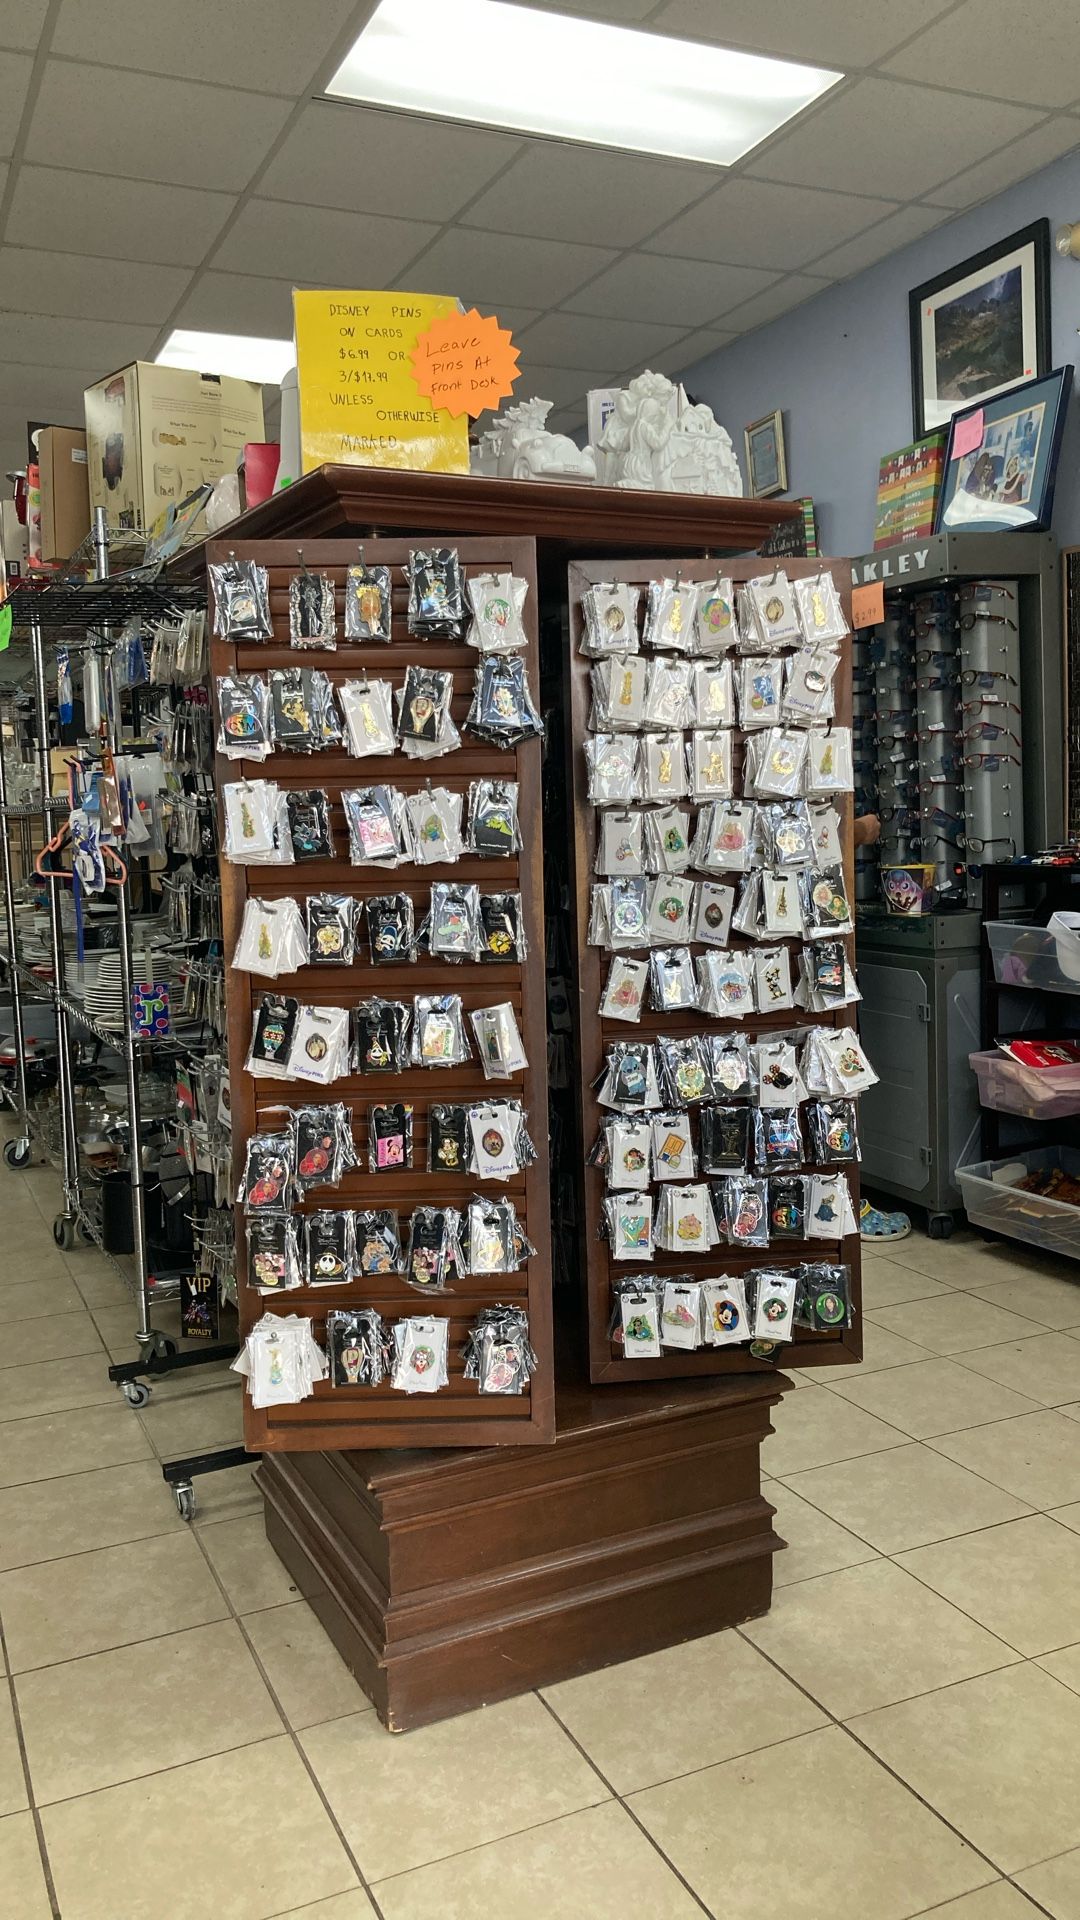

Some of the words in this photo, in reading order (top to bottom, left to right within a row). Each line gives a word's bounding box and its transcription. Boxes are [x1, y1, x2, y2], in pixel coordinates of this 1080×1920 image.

[329, 304, 370, 316] DISNEY
[391, 306, 422, 318] PINS
[339, 327, 355, 338] ON
[365, 328, 403, 338] CARDS
[426, 337, 481, 357] Leave
[388, 351, 406, 361] OR
[329, 392, 374, 406] UNLESS
[376, 410, 440, 423] OTHERWISE
[340, 434, 397, 452] MARKED
[185, 1276, 211, 1293] VIP
[187, 1328, 212, 1336] ROYALTY
